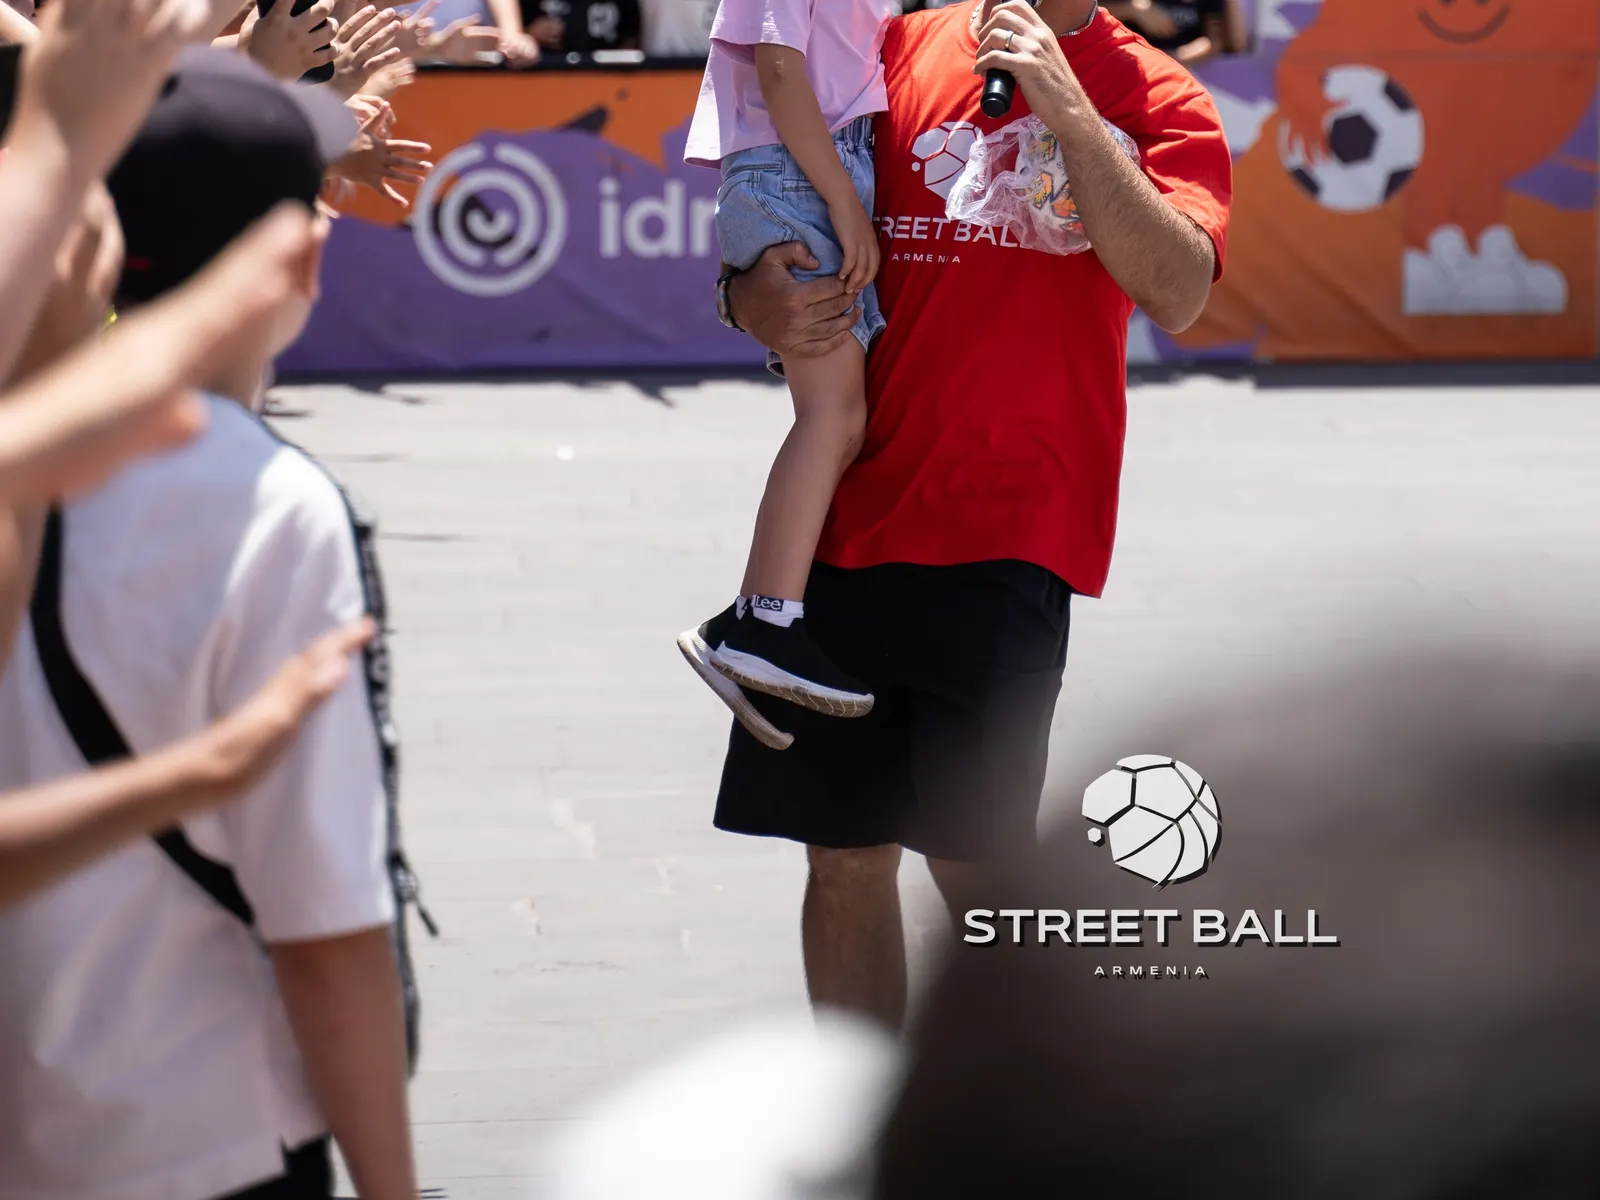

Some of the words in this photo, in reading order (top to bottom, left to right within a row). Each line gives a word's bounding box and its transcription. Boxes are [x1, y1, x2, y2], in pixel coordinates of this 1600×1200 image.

[598, 177, 718, 259] idr
[872, 215, 951, 240] REET
[755, 595, 782, 611] Lee
